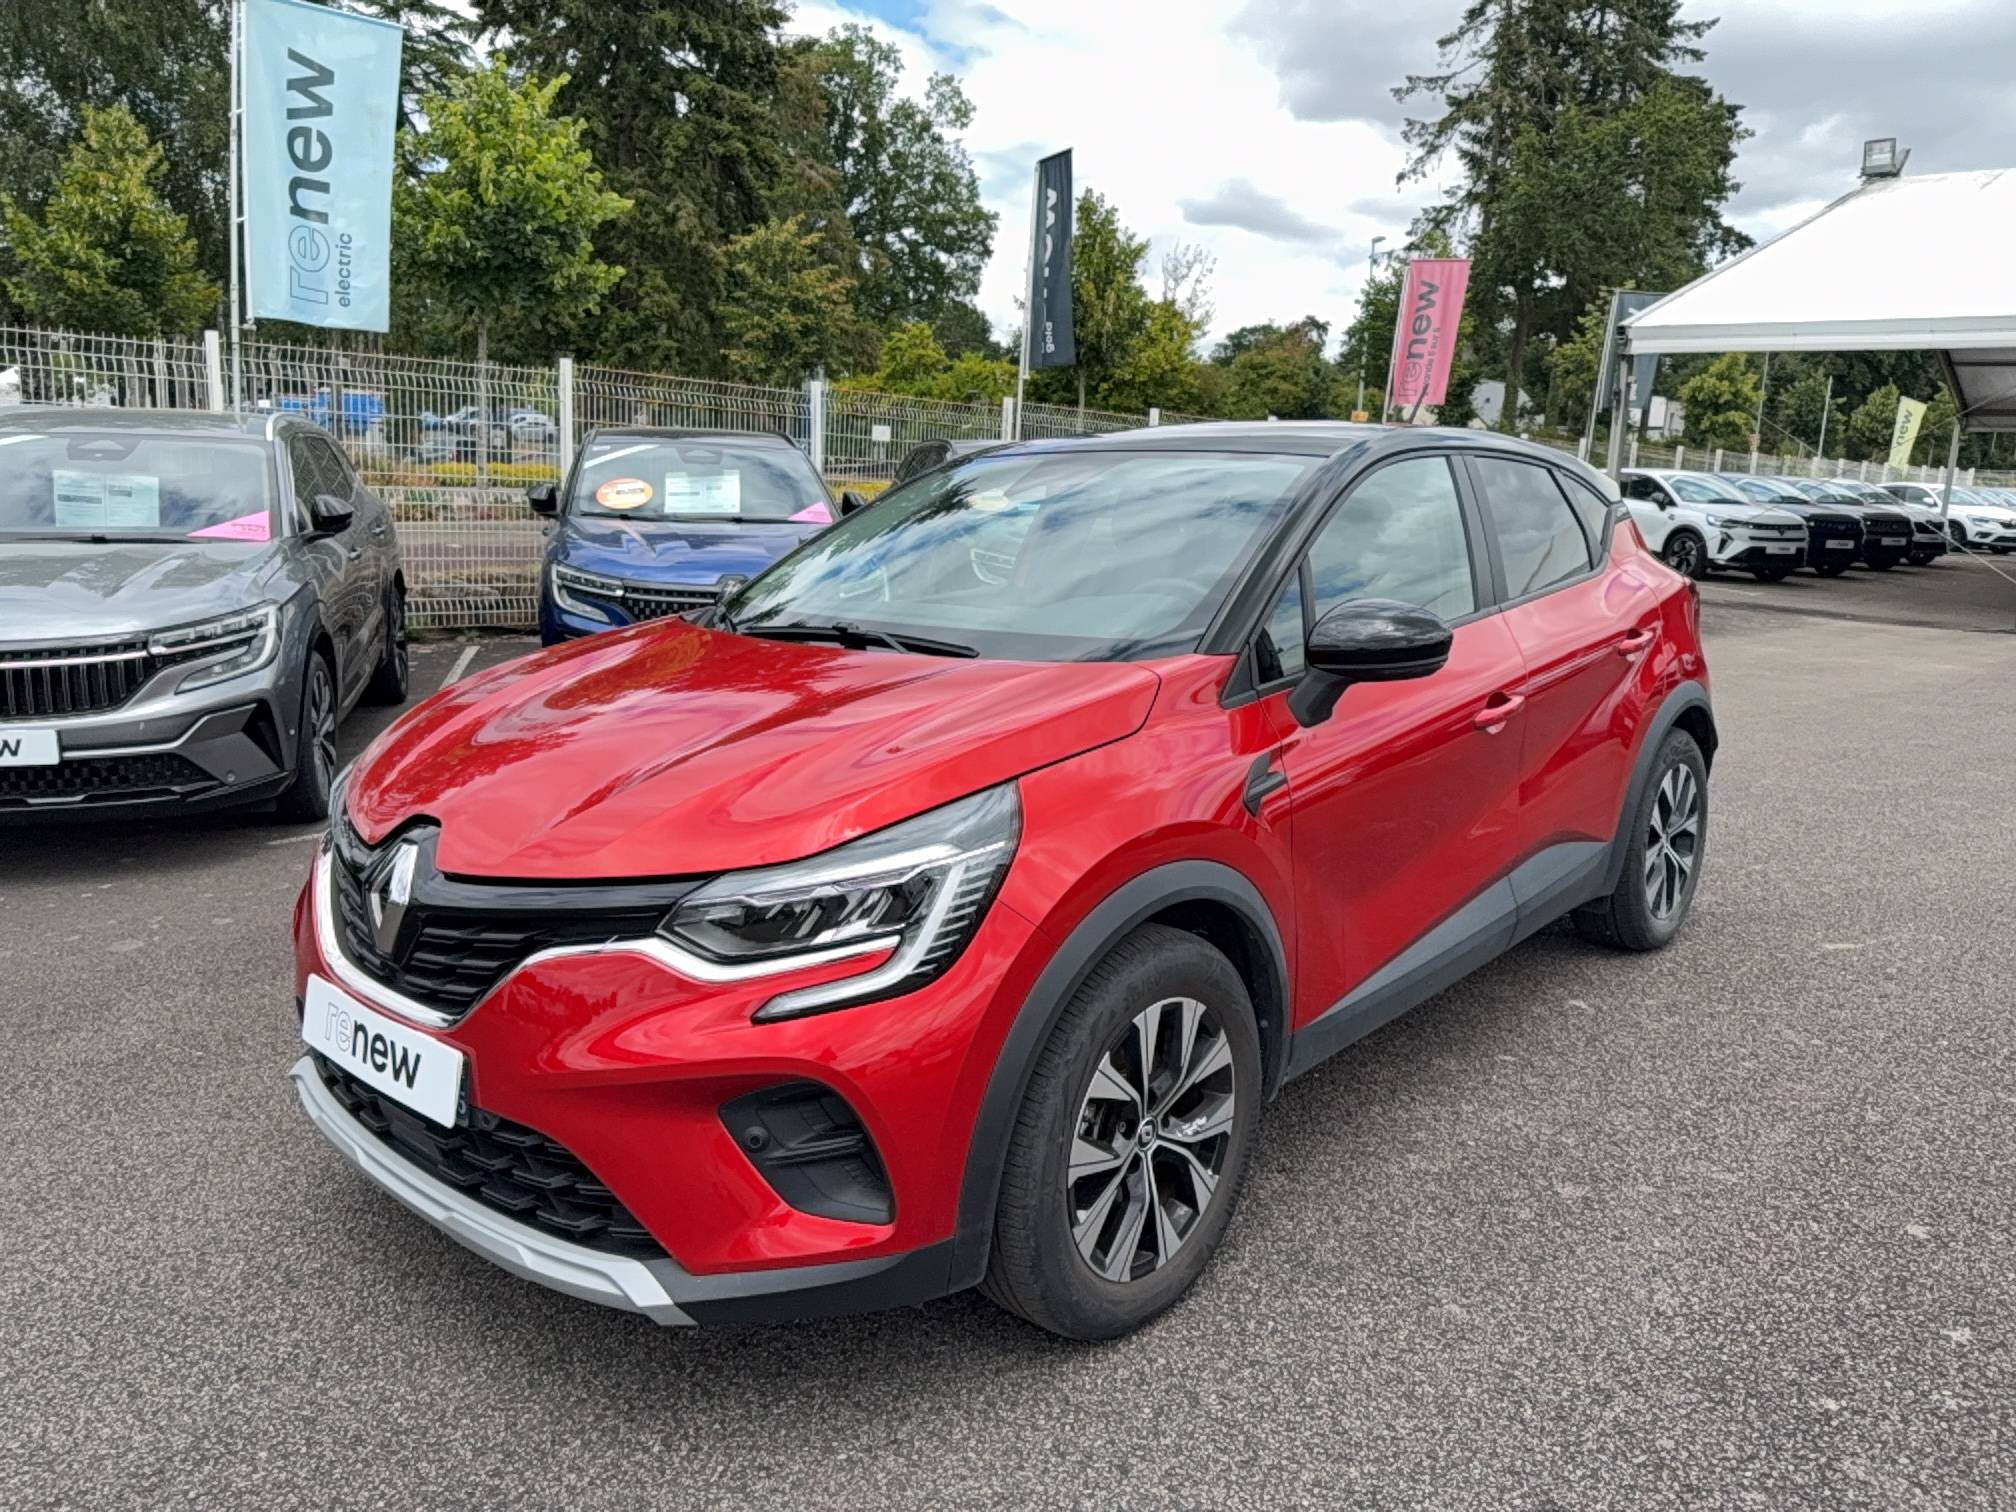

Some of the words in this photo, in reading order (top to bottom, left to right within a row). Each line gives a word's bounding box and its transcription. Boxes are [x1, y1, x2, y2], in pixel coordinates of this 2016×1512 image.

[286, 47, 335, 305] renew
[334, 232, 352, 308] electric
[1044, 321, 1056, 353] gold
[1398, 279, 1440, 398] renew
[324, 1002, 421, 1090] renew
